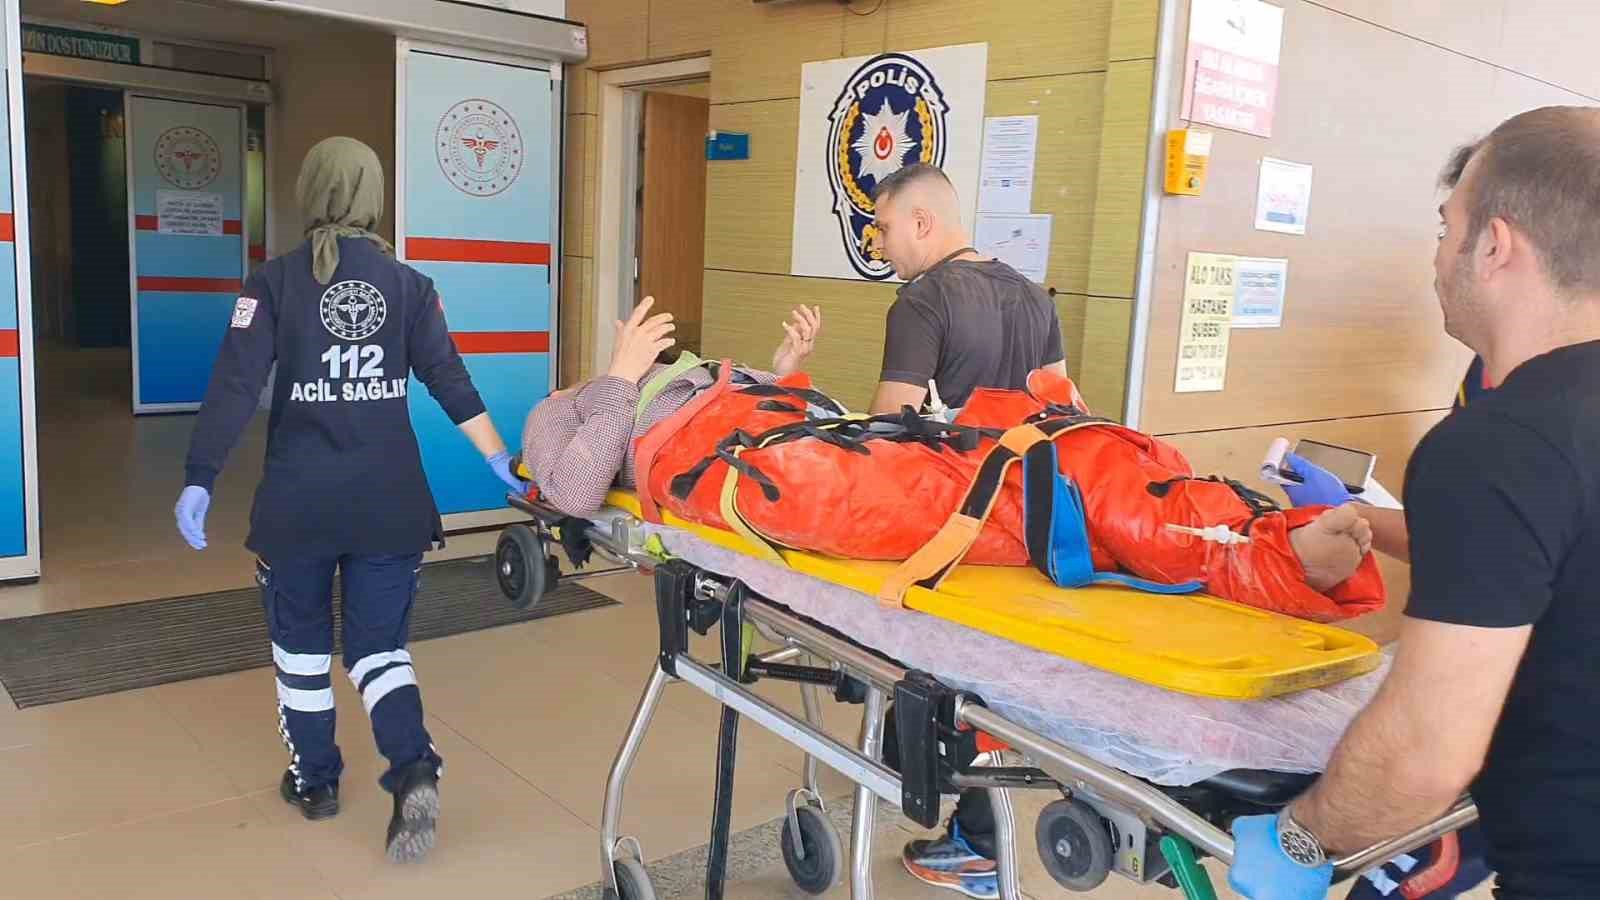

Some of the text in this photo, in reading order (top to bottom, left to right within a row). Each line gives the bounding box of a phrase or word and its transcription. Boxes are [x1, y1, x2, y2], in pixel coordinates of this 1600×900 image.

[856, 67, 919, 98] POLİS
[321, 344, 384, 379] 112
[290, 376, 407, 402] ACİL SAĞLIK
